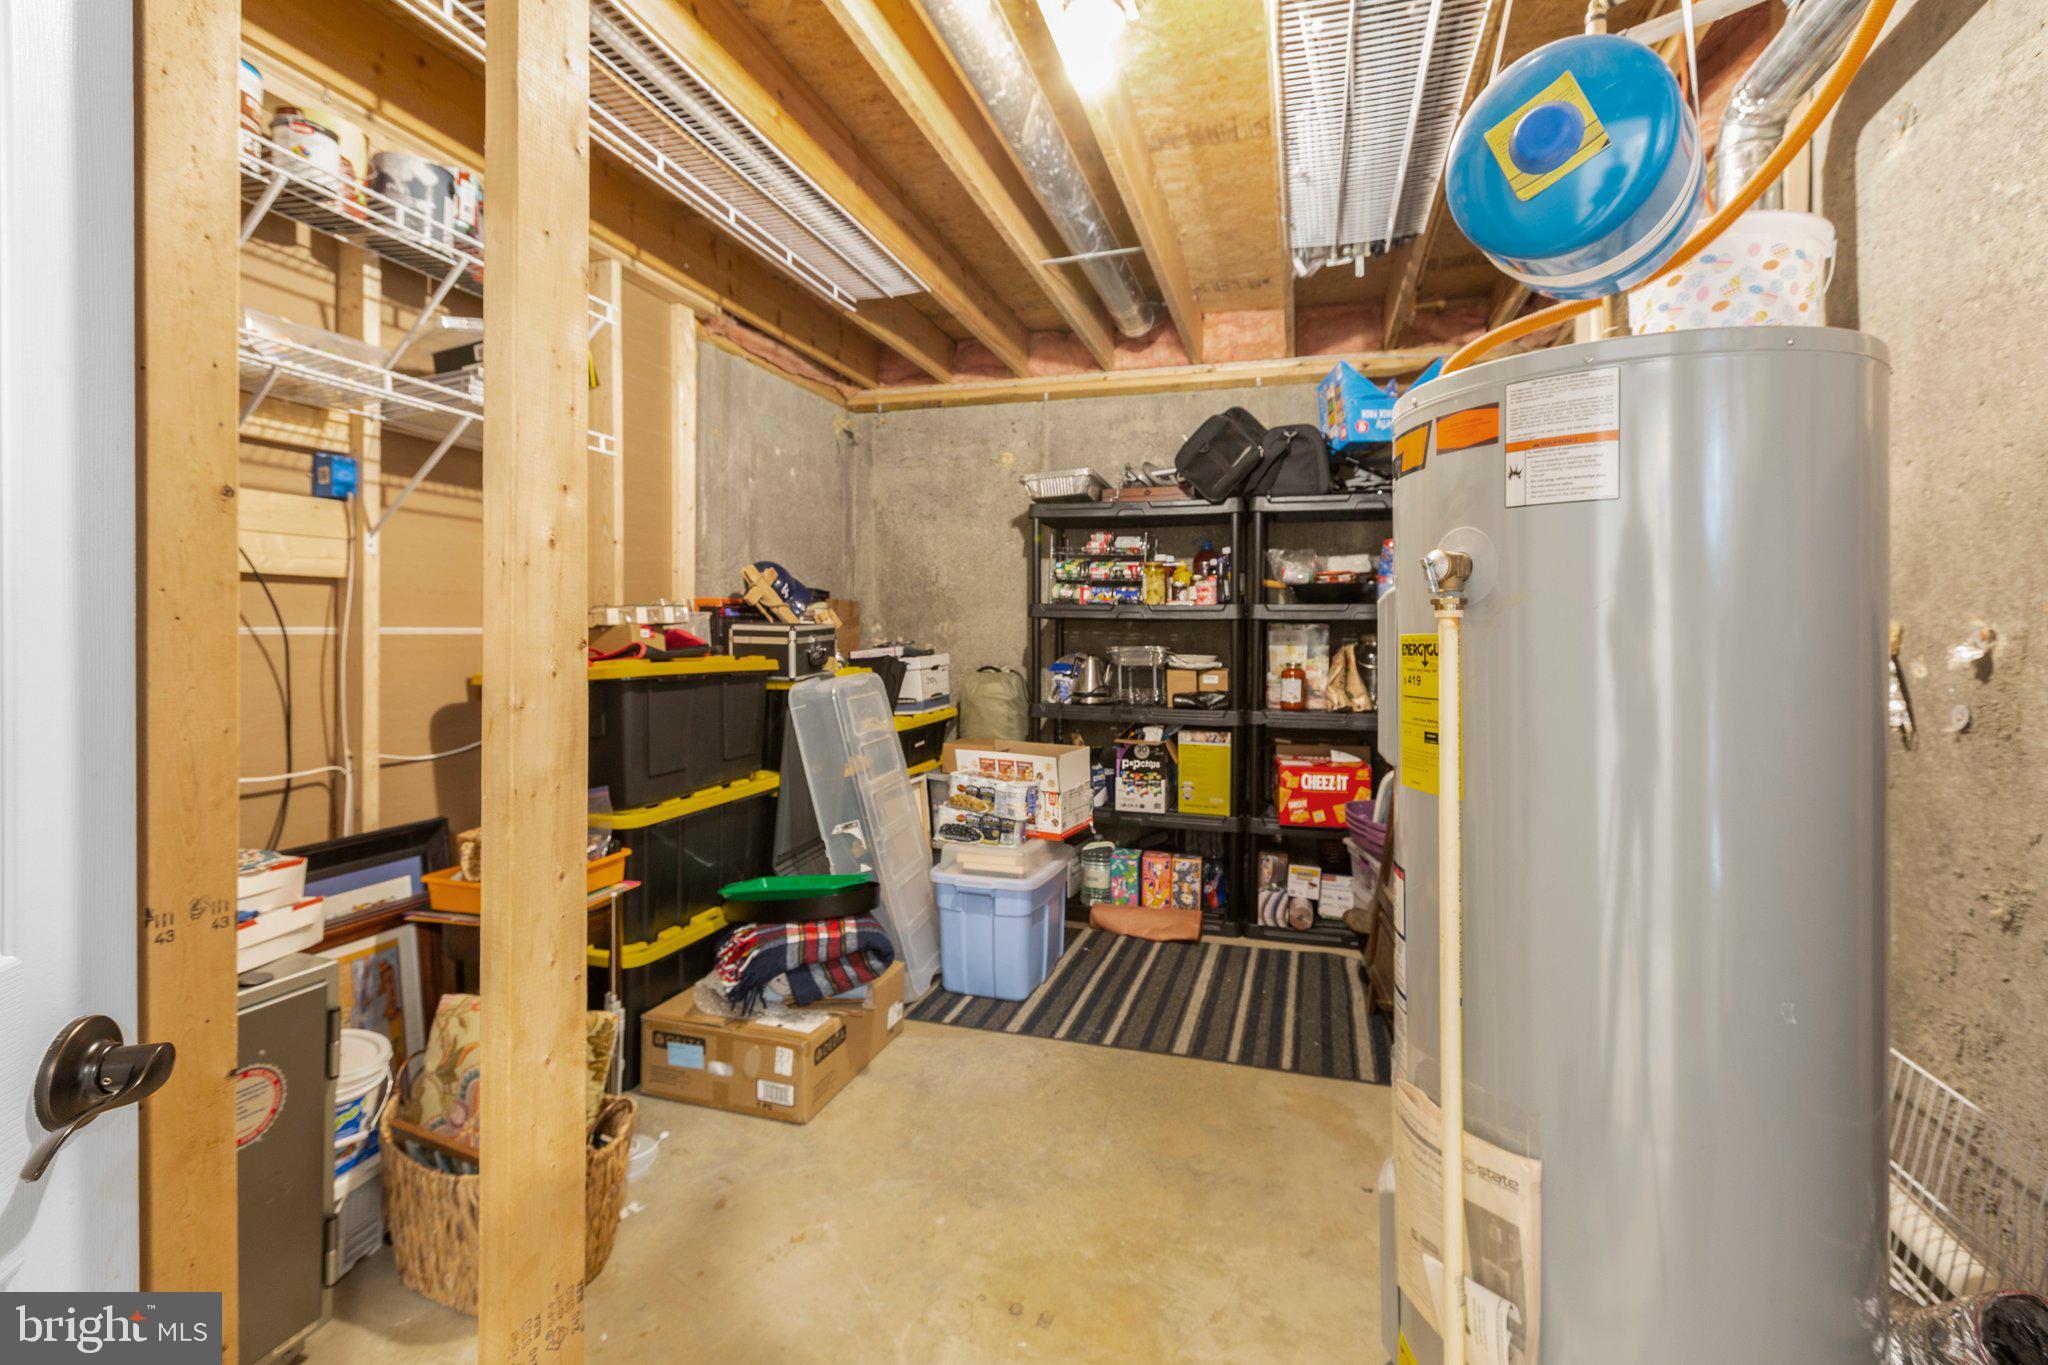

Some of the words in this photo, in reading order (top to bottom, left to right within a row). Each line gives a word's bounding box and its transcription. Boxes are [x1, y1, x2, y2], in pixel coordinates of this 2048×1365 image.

[1122, 758, 1161, 770] popchips
[211, 915, 230, 929] 43
[154, 929, 175, 944] 43
[1478, 1165, 1519, 1191] state
